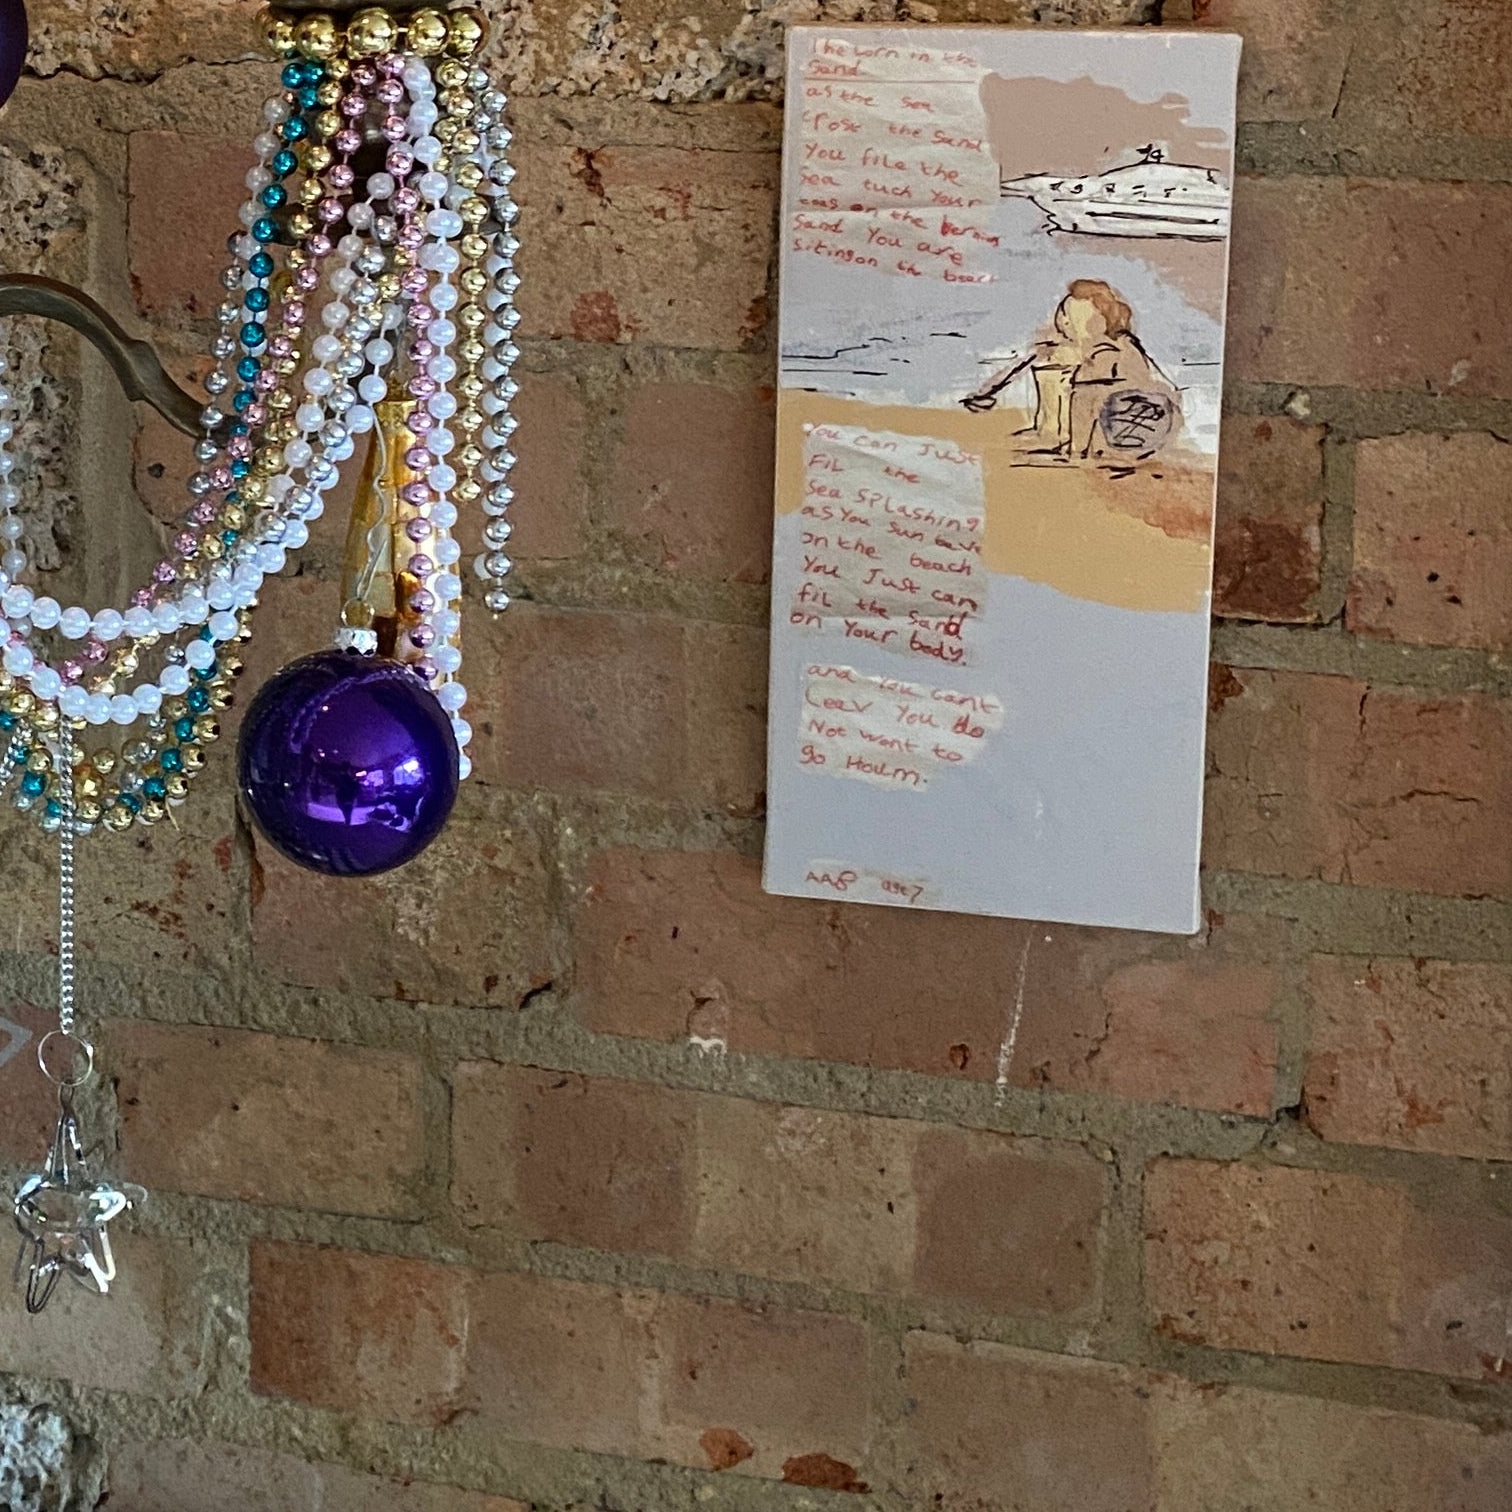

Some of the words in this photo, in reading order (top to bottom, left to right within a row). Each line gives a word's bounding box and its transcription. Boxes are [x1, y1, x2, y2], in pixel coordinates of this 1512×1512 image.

[837, 538, 881, 559] the
[790, 612, 822, 629] on
[932, 744, 964, 762] to
